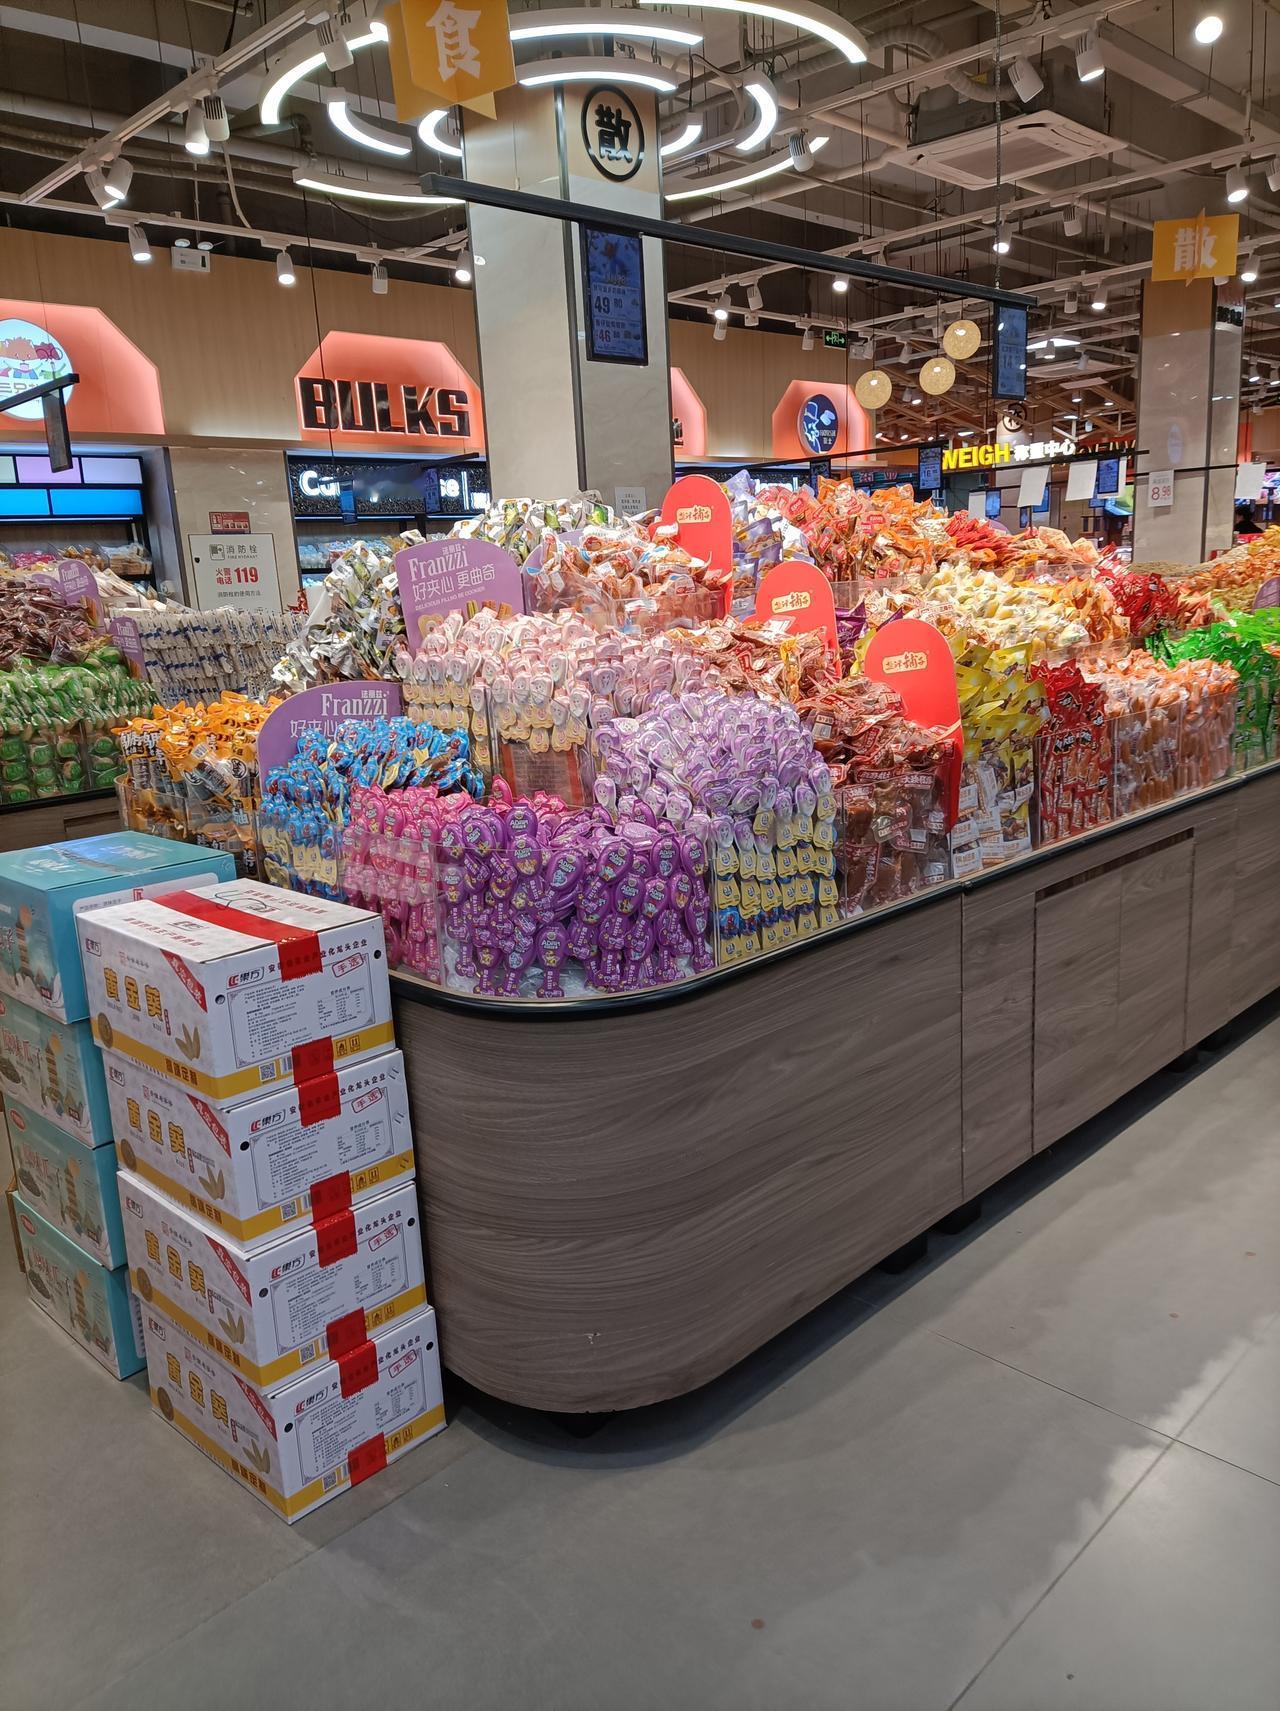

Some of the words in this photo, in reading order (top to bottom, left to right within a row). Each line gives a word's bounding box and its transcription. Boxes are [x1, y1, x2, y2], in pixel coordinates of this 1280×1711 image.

[425, 0, 481, 82] 食
[595, 103, 633, 162] 散
[594, 295, 611, 315] 49
[298, 376, 471, 437] BULKS
[941, 442, 1011, 471] WEIGH
[226, 544, 258, 554] 消防栓
[215, 567, 231, 577] 火警
[234, 566, 259, 584] 119
[408, 546, 468, 582] Franzzi
[216, 576, 233, 585] 电话
[412, 576, 454, 603] 好夹心
[456, 563, 496, 590] 更曲奇
[321, 693, 388, 716] Franzzi
[290, 719, 337, 738] 好夹心
